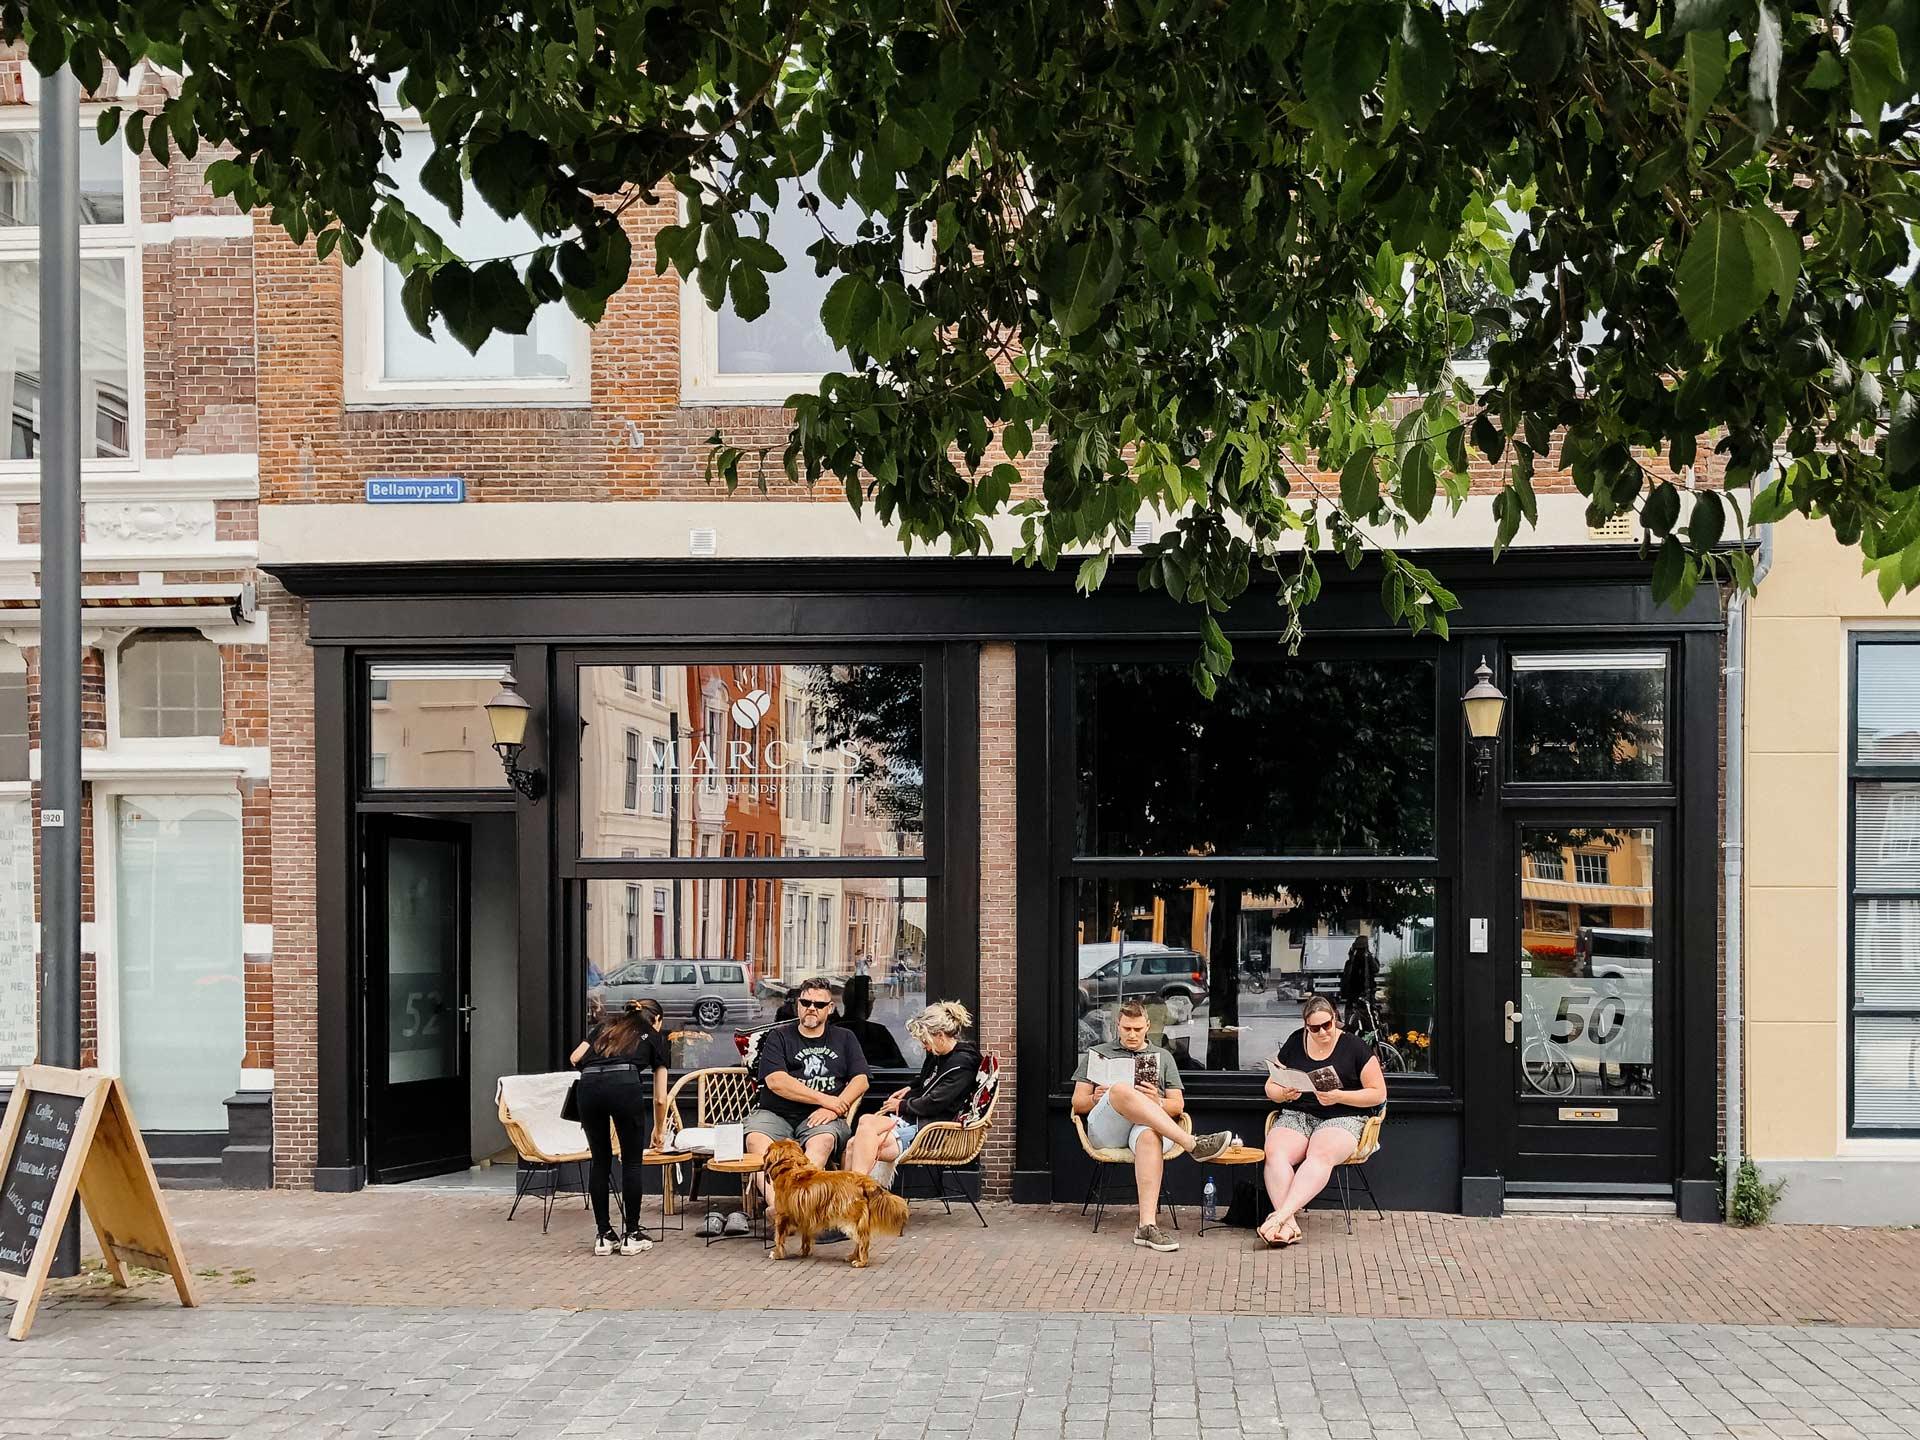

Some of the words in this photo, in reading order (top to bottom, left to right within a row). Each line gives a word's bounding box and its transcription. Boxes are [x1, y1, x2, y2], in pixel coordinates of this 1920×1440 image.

[372, 483, 454, 498] Bellamypark
[643, 739, 861, 770] MARCUS
[698, 784, 721, 794] TEA
[725, 783, 778, 794] BLENDS
[779, 784, 790, 794] &
[791, 783, 864, 794] LIFESTYLE
[401, 991, 442, 1038] 52
[1549, 996, 1626, 1045] 50
